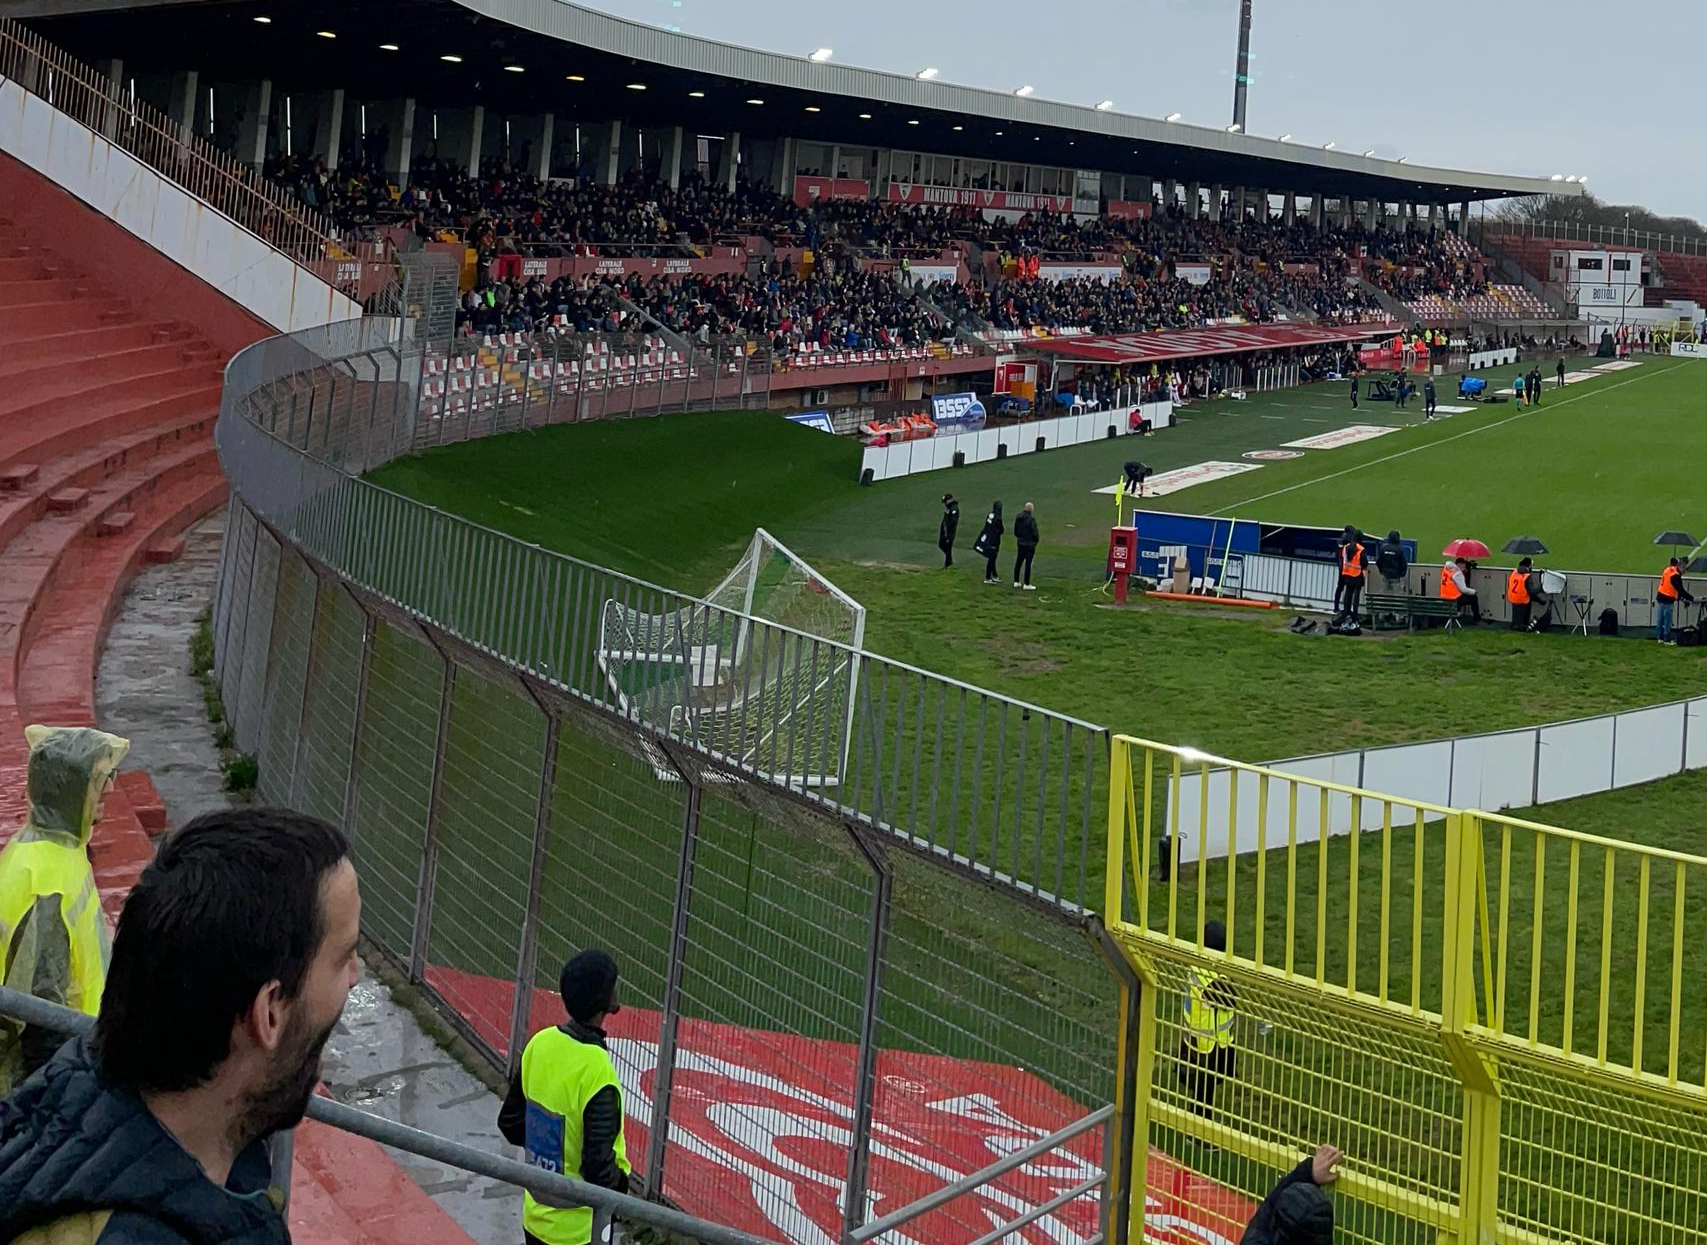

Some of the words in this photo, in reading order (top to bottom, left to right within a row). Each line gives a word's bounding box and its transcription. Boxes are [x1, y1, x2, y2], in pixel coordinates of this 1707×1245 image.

[924, 187, 957, 205] MANTOVA
[961, 192, 976, 205] 1911
[1005, 195, 1034, 209] MANTOVA
